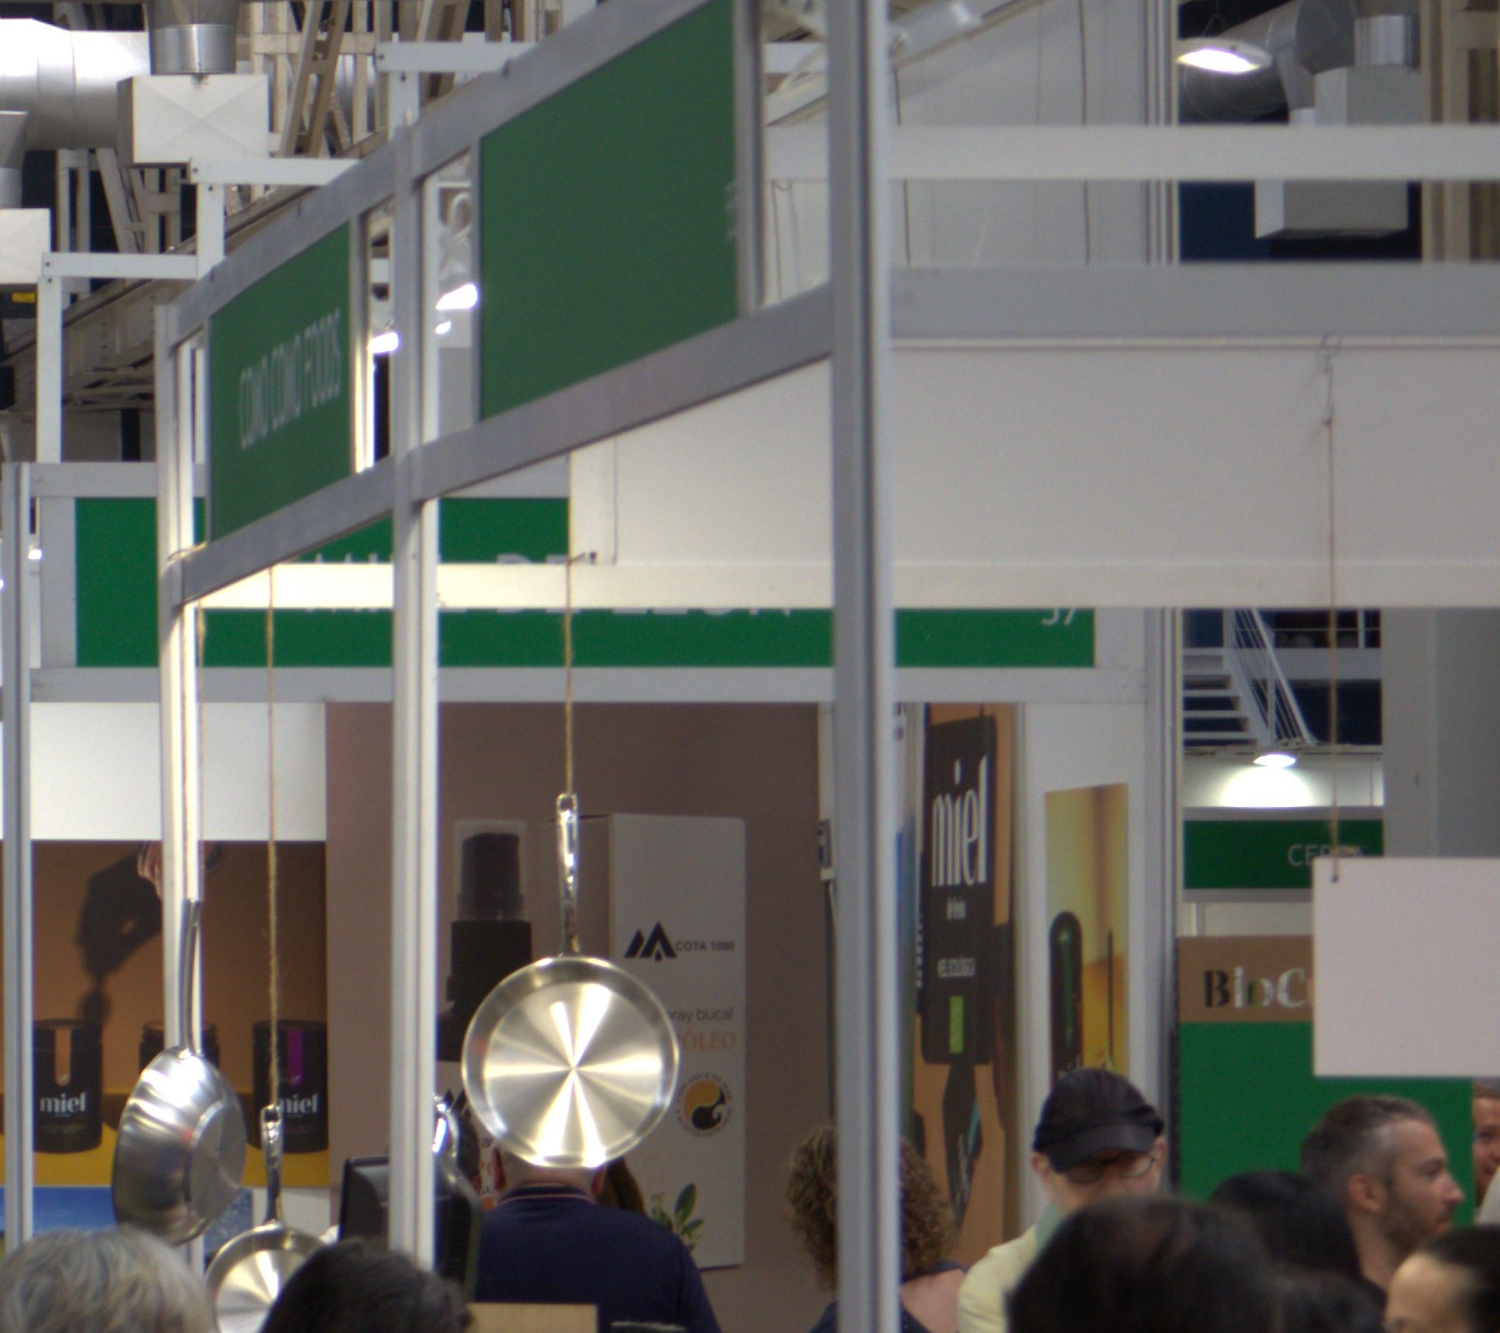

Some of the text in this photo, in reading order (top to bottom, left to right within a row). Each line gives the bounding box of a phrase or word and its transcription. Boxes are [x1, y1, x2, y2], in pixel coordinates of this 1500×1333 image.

[931, 754, 990, 887] miel
[675, 940, 706, 952] COTA
[696, 1007, 734, 1021] bucal
[681, 1028, 737, 1051] ÓLEO
[39, 1092, 88, 1114] miel
